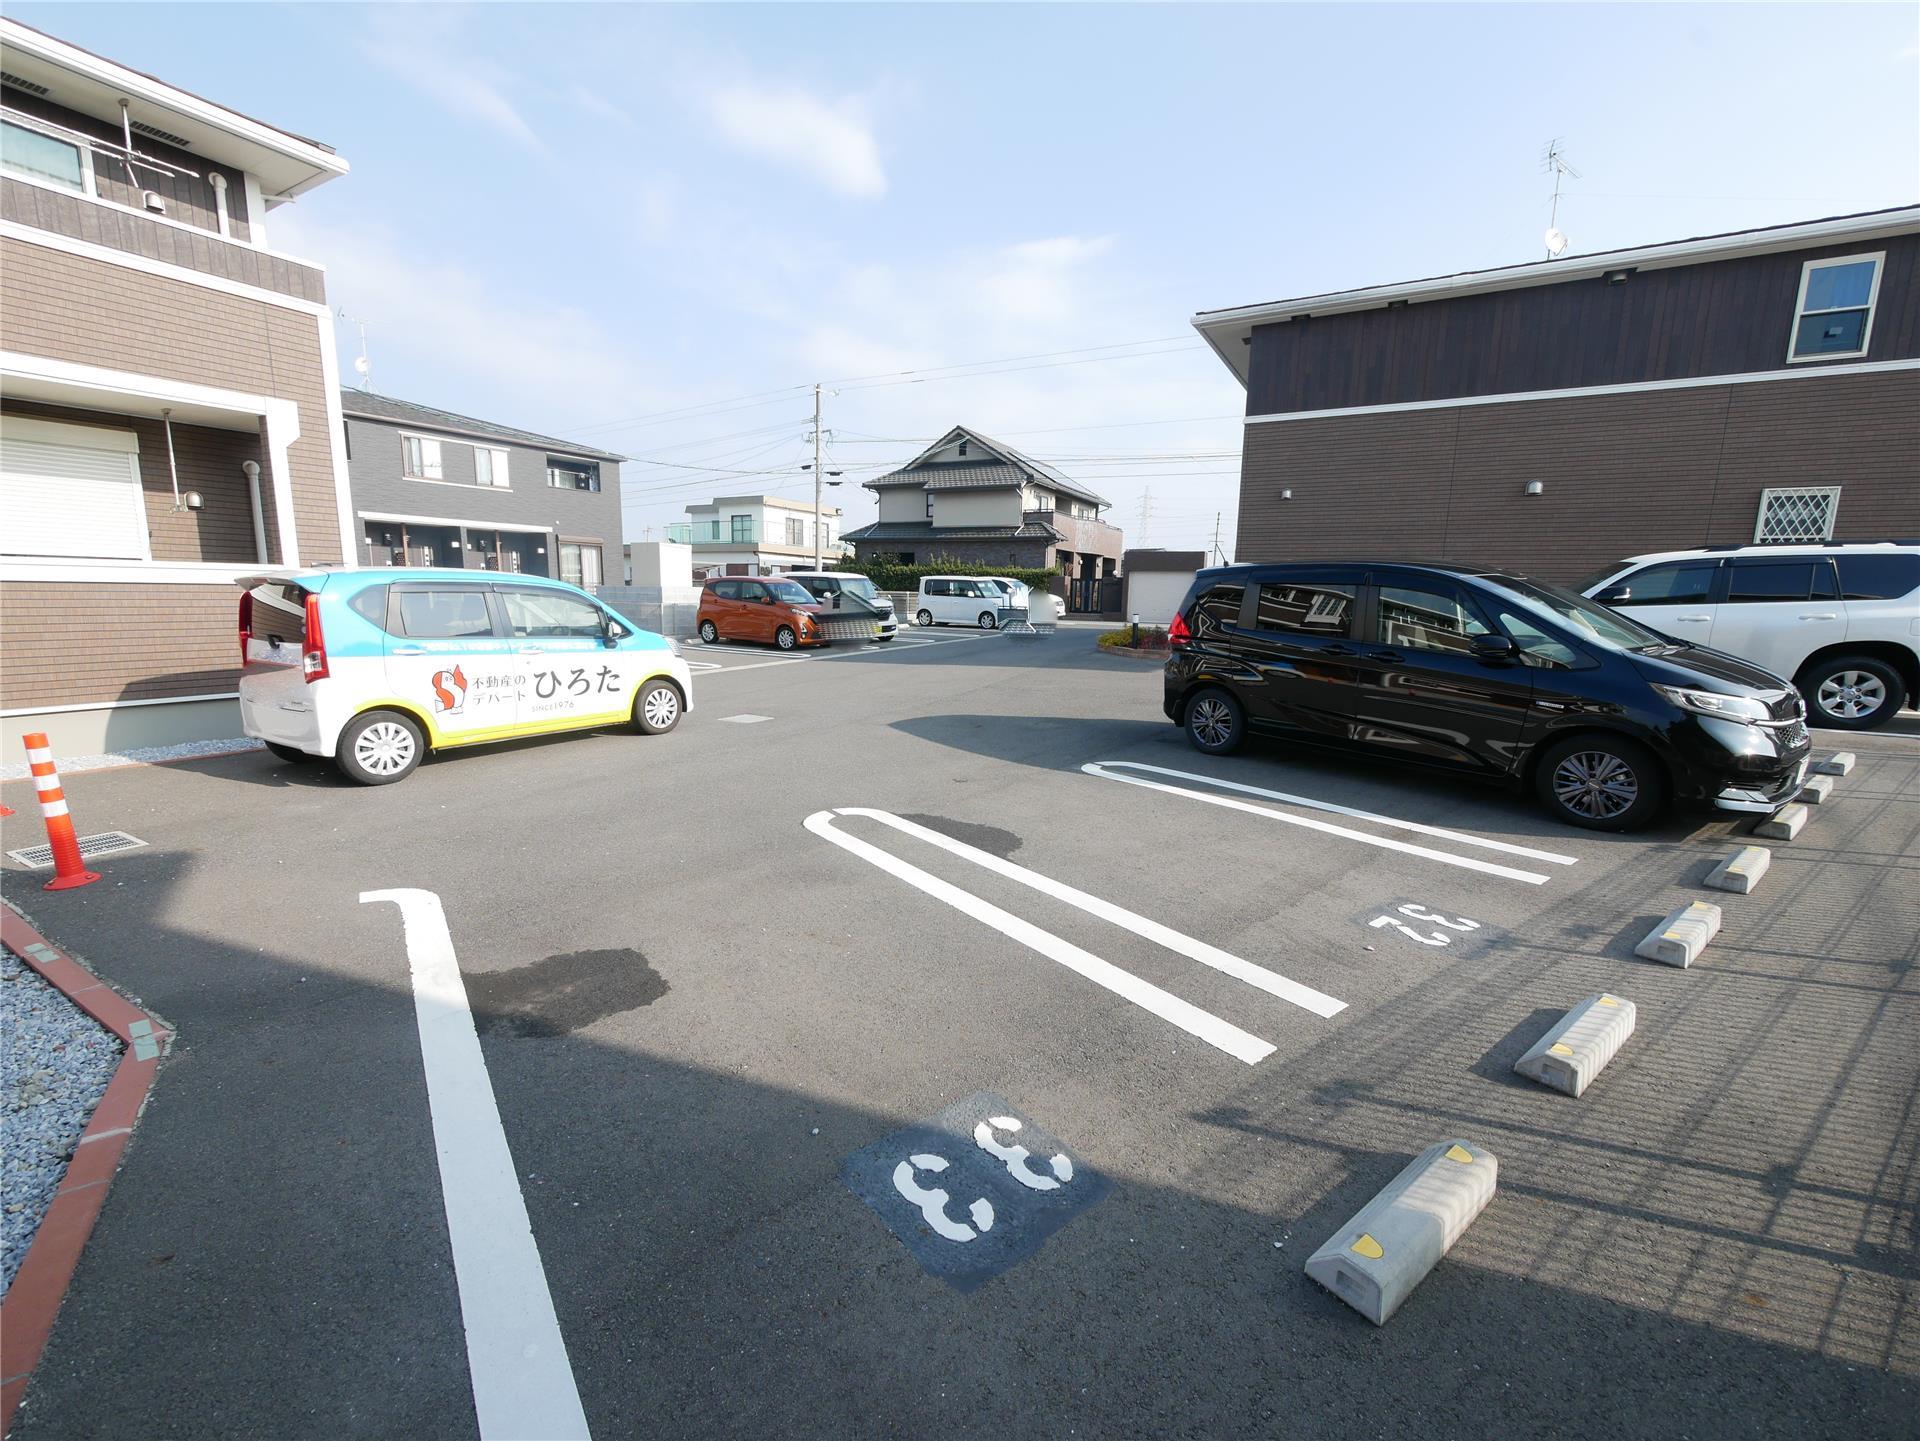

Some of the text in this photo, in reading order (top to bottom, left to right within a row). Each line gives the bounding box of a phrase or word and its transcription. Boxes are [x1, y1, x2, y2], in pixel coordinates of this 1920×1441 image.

[472, 673, 526, 690] 不動産の
[534, 665, 620, 698] ひろた
[1368, 904, 1481, 946] 32
[893, 1116, 1073, 1242] 33
